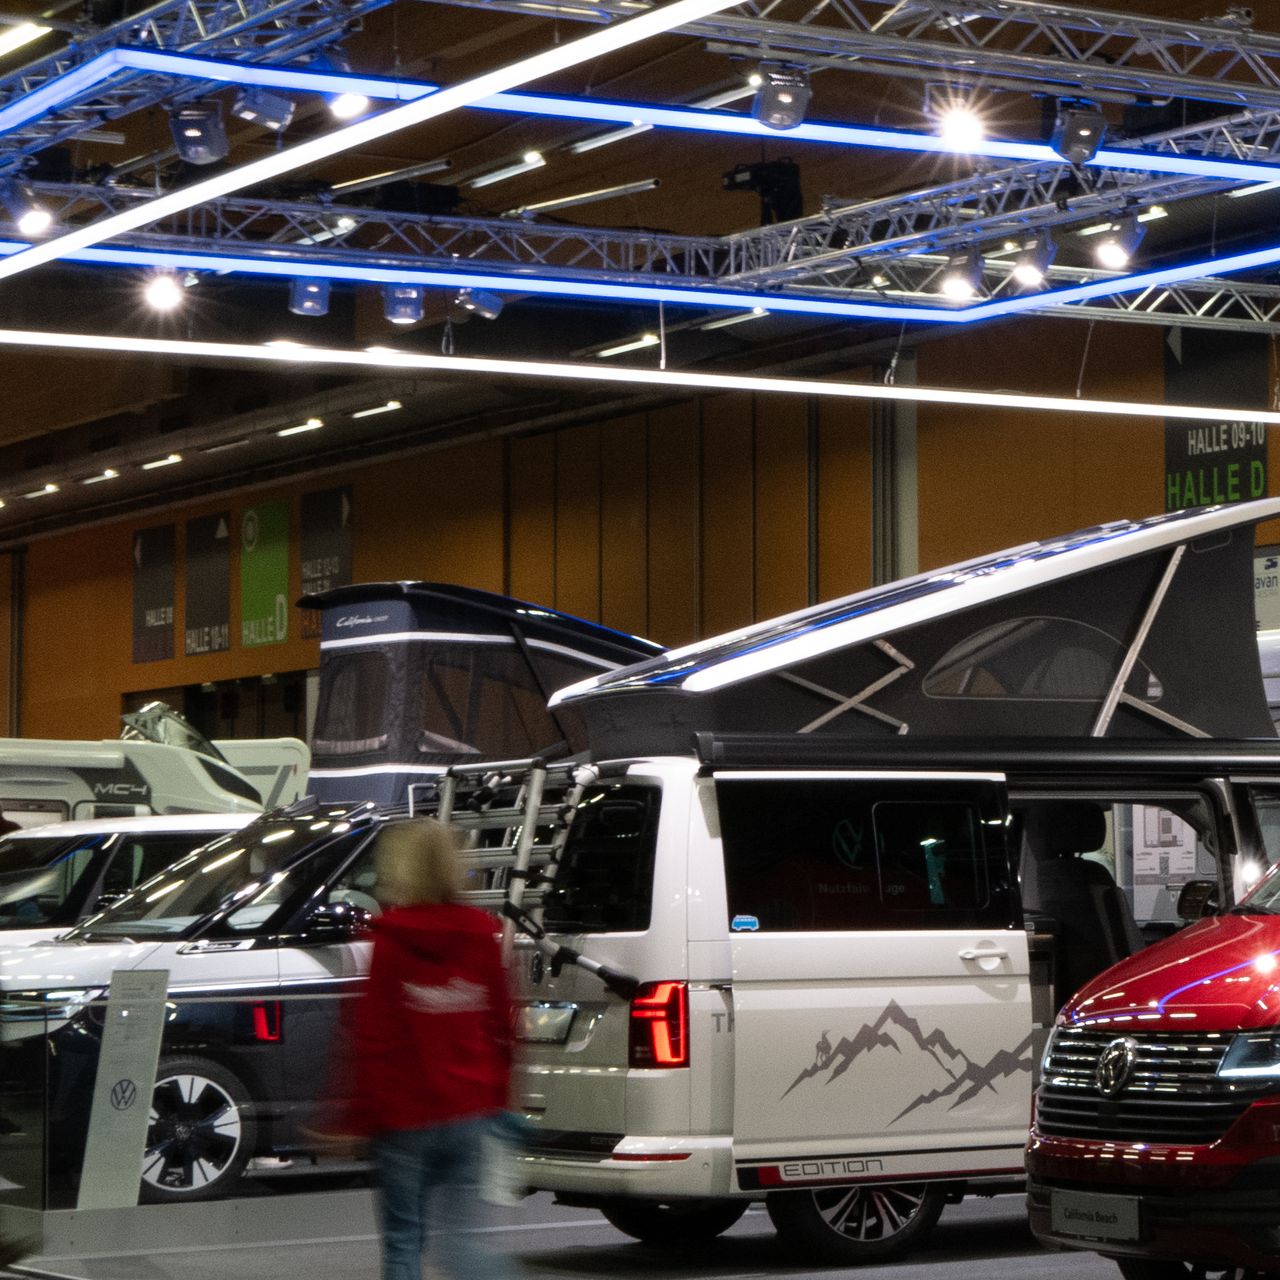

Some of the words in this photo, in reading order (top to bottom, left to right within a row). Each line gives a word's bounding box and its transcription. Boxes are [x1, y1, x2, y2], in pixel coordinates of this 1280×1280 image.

[1188, 424, 1228, 456] HALLE
[1231, 420, 1265, 449] 09-10
[1167, 463, 1240, 510] HALLE
[1250, 460, 1265, 497] D
[1254, 575, 1278, 589] avan
[242, 616, 274, 644] HALLE
[275, 593, 287, 640] D
[95, 783, 148, 796] MC4
[784, 1160, 883, 1177] EDITION
[1064, 1207, 1094, 1222] California
[1096, 1211, 1118, 1224] Beach
